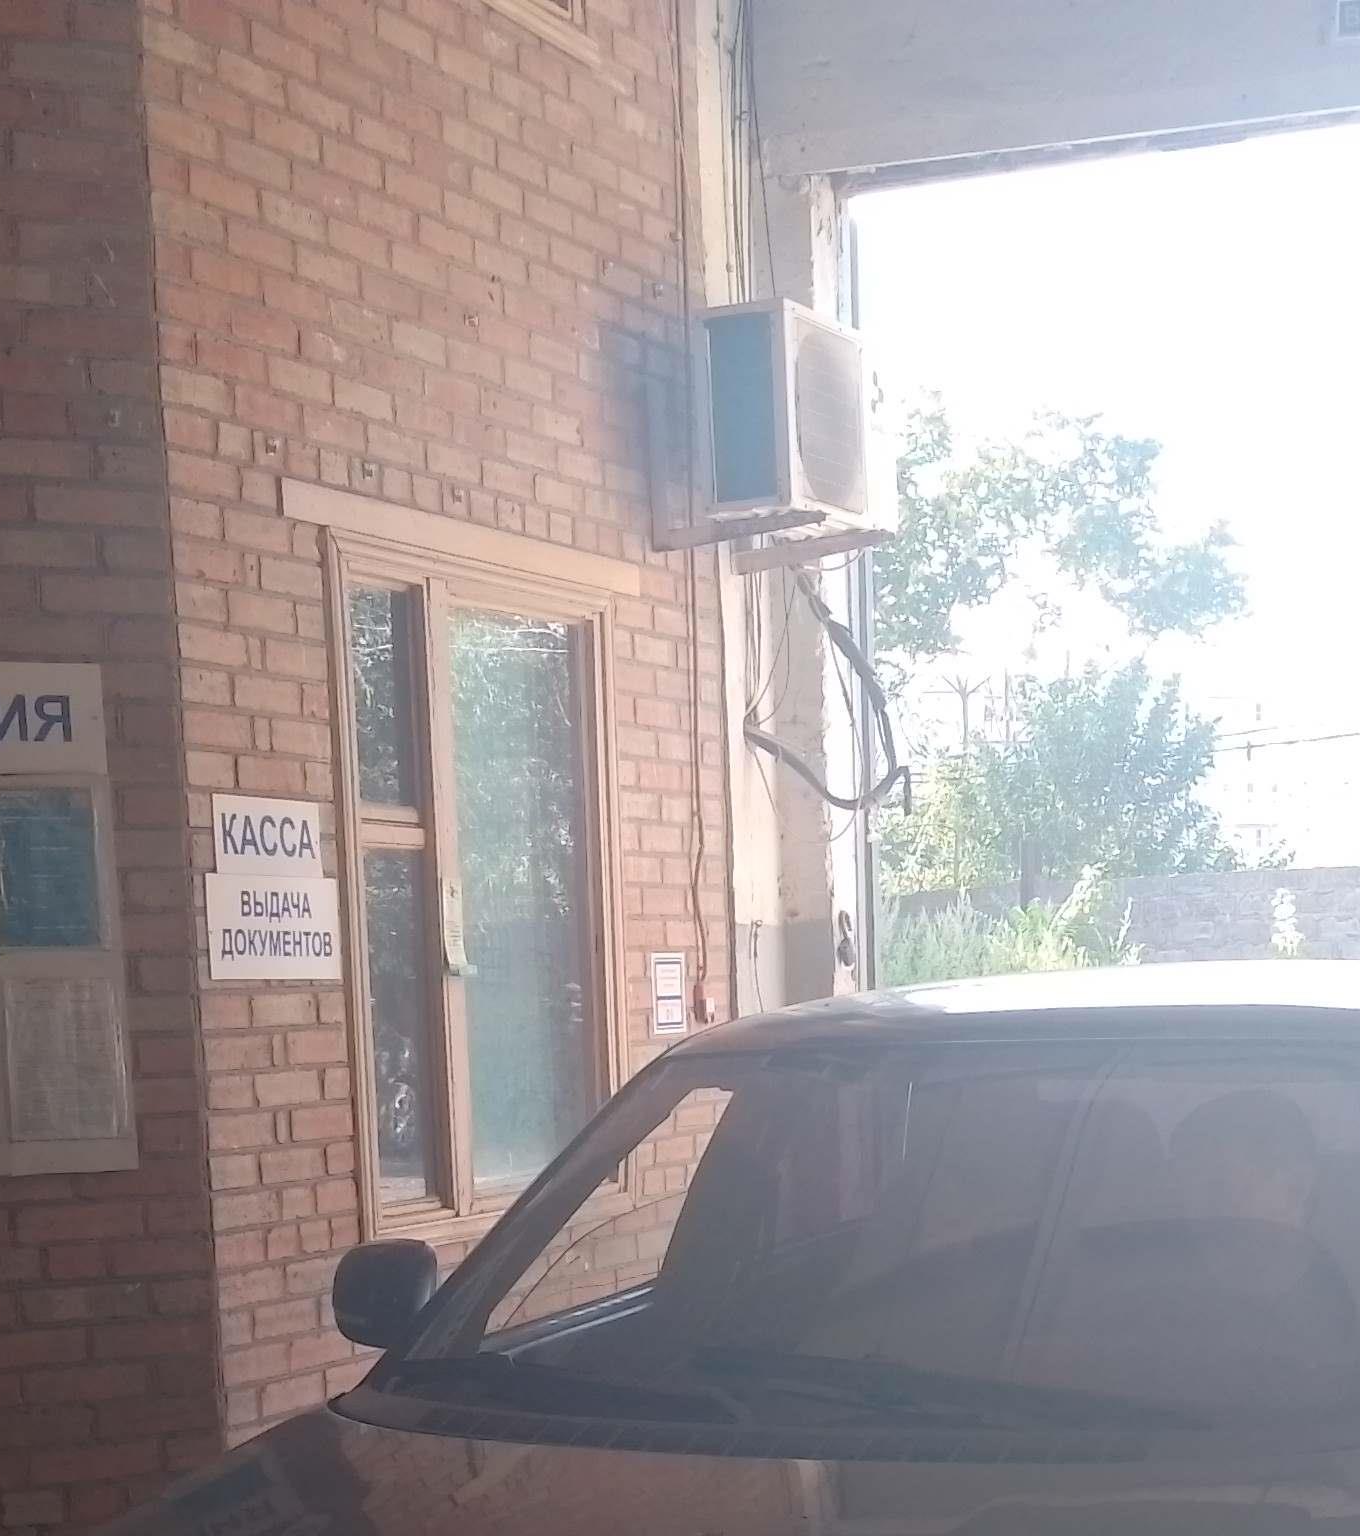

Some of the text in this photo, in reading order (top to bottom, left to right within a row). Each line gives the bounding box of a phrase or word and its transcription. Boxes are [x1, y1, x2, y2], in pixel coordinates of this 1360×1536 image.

[221, 813, 316, 859] КАССА
[241, 891, 312, 922] ВЫДАЧА
[221, 929, 333, 961] ДОКУМЕНТОВ
